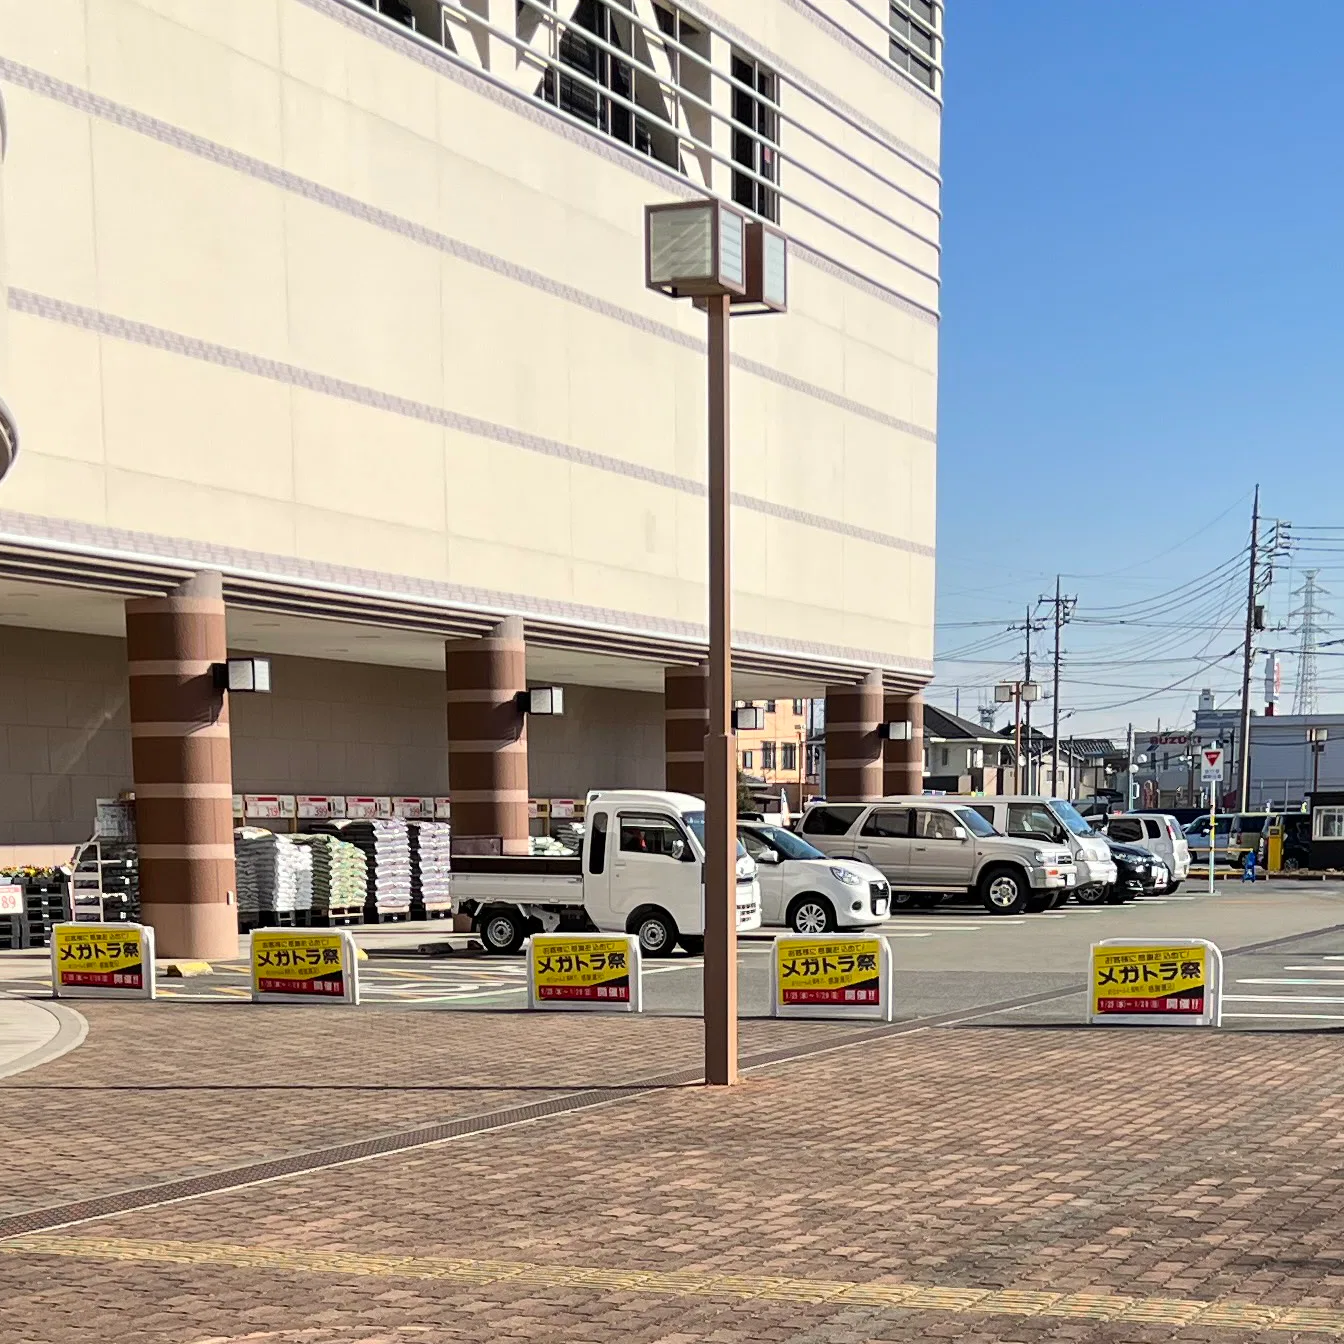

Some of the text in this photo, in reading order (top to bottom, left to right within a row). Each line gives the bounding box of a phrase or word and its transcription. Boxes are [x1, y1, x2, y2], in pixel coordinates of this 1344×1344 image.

[1149, 736, 1202, 745] SUZUI
[1, 895, 17, 909] 89
[60, 942, 140, 961] メガトラ祭
[257, 948, 340, 967] メガトラ祭
[537, 952, 627, 974] メガトラ祭
[782, 953, 877, 978] メガトラ祭
[1097, 961, 1202, 986] メガトラ祭
